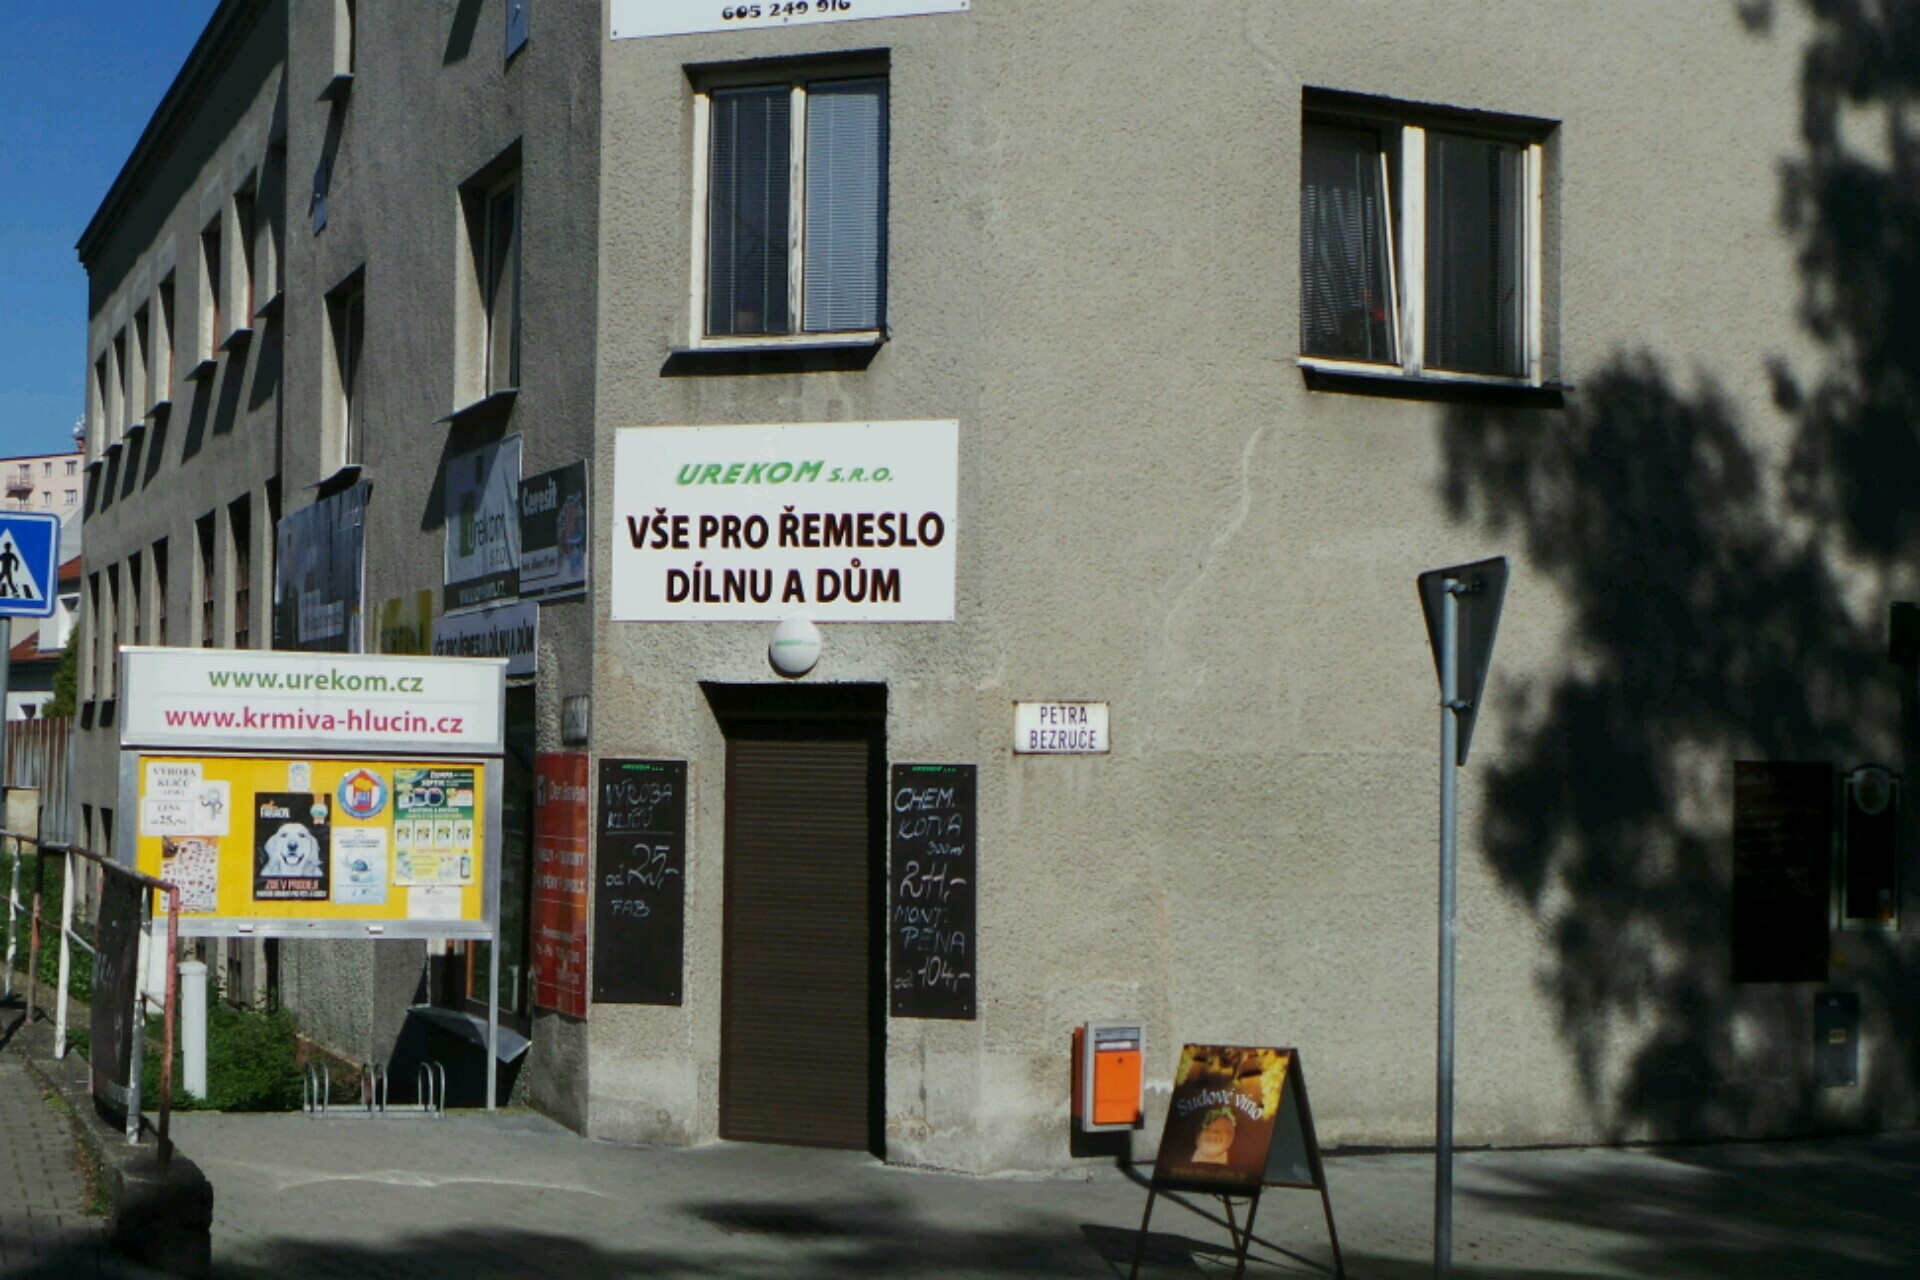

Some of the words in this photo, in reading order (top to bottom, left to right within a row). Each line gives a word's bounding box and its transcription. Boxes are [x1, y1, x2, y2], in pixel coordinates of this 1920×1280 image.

[769, 1, 808, 16] 249
[676, 460, 824, 486] UREKOM
[827, 467, 894, 483] S.R.O.
[523, 477, 557, 516] Ceresit
[627, 507, 690, 549] VŠE
[699, 515, 769, 549] PRO
[778, 505, 945, 549] ŘEMESLO
[666, 561, 773, 604] DÍLNU
[782, 569, 806, 604] A
[817, 557, 901, 604] DŮM
[208, 668, 424, 693] www.urekom.cz
[165, 706, 464, 734] www.krmiva-hlucin.cz
[1040, 706, 1087, 725] PETRA
[1030, 726, 1097, 750] BEZRUČE
[1176, 1087, 1236, 1117] Sudové
[1235, 1091, 1265, 1121] víno
